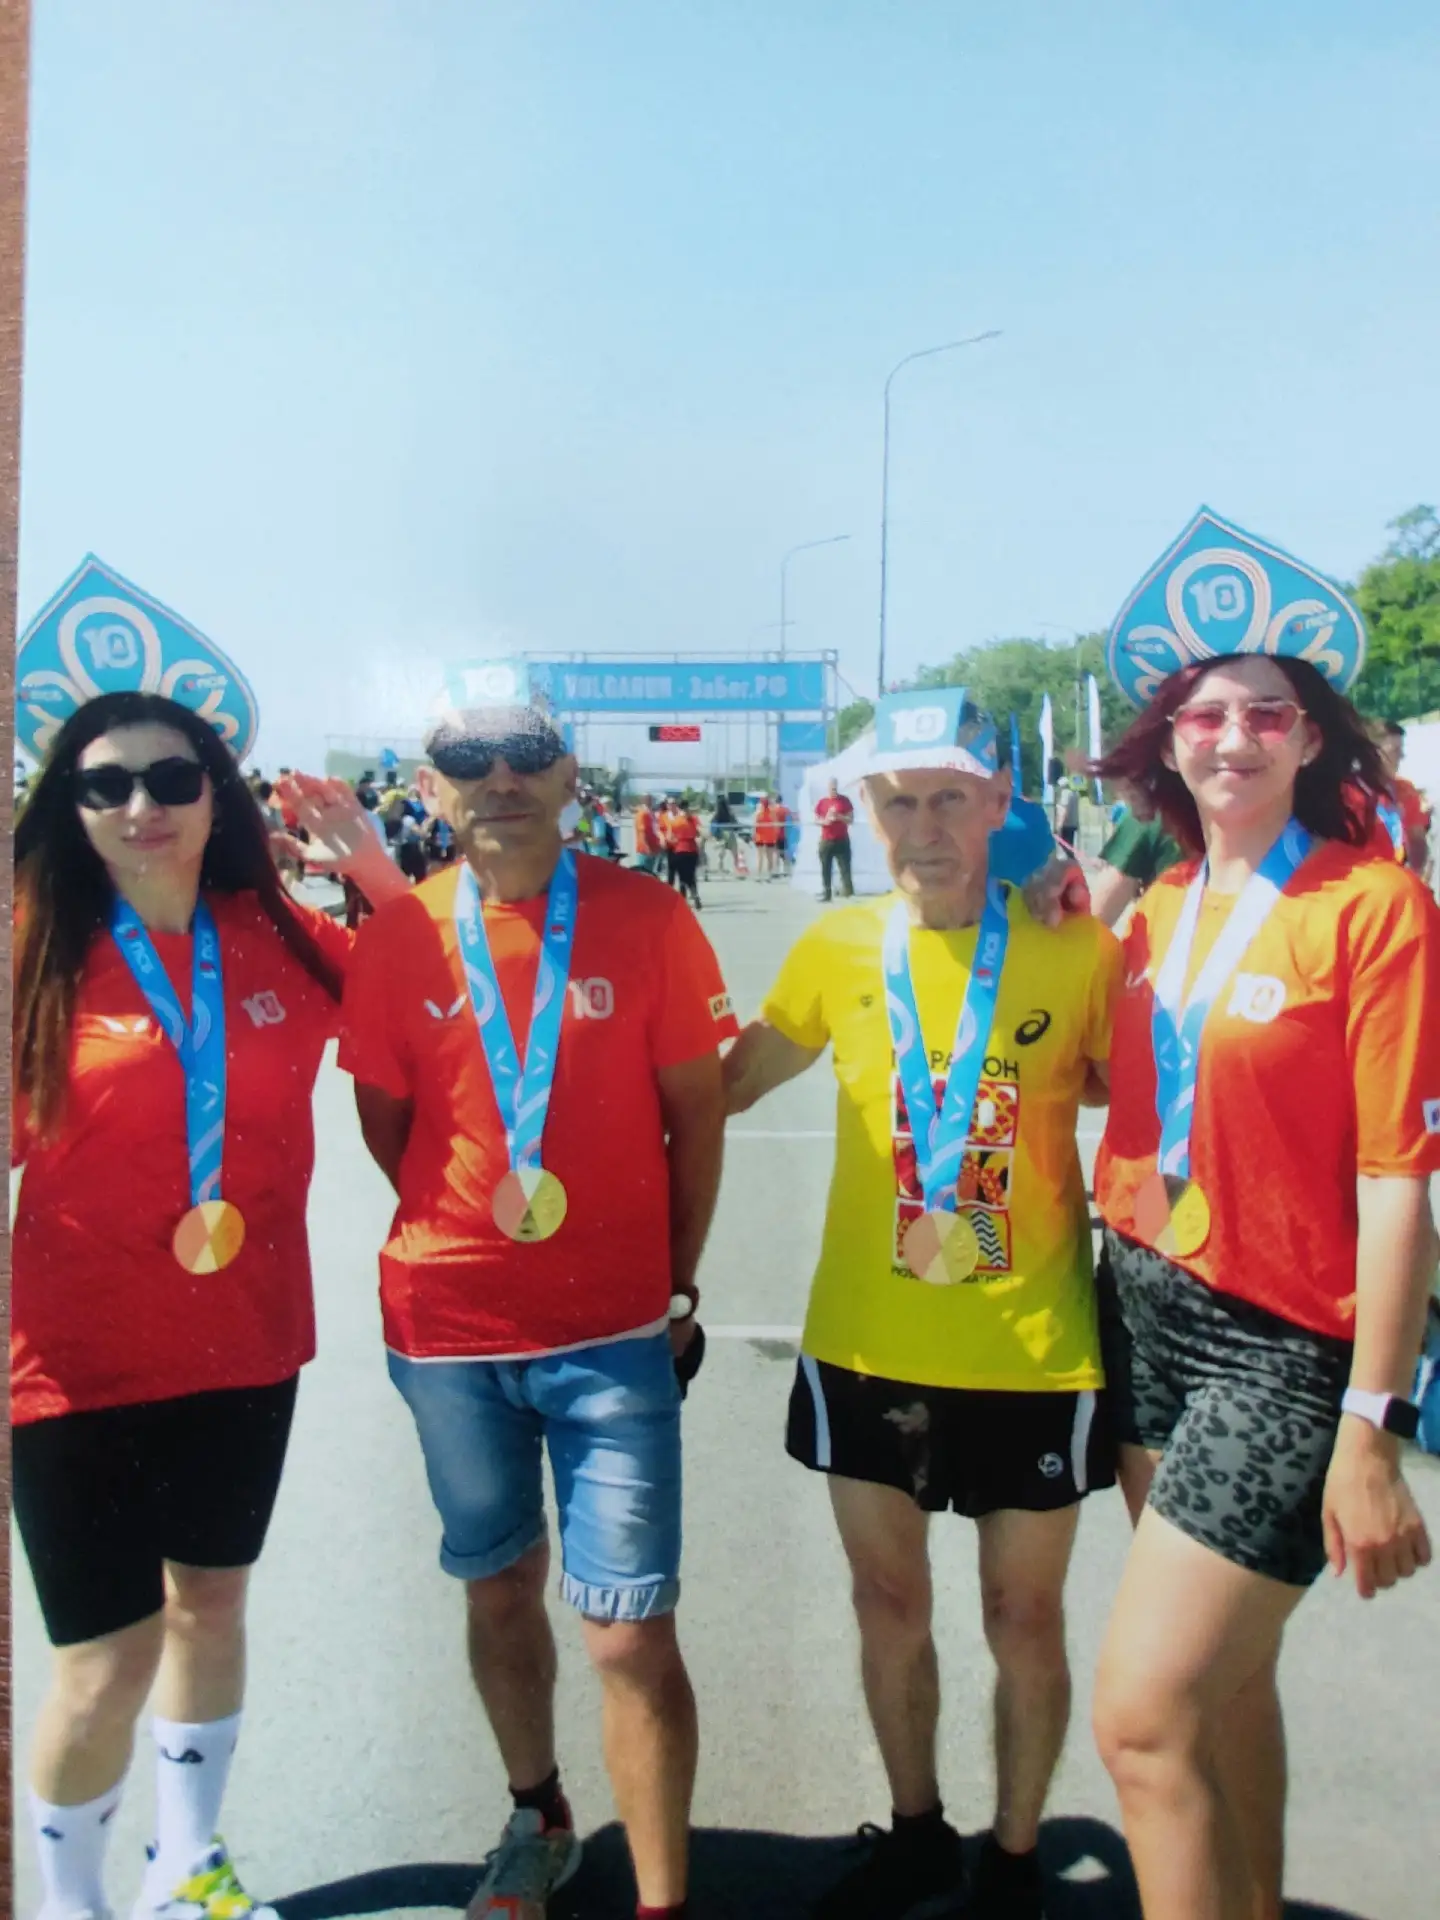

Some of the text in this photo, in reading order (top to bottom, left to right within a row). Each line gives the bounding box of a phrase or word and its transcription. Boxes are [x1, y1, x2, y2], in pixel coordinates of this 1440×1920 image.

[1189, 575, 1246, 622] 10
[82, 625, 138, 669] 10
[461, 665, 516, 703] 10
[890, 707, 947, 744] 10
[241, 989, 286, 1028] 10
[569, 977, 614, 1020] 10
[1226, 972, 1286, 1023] 10
